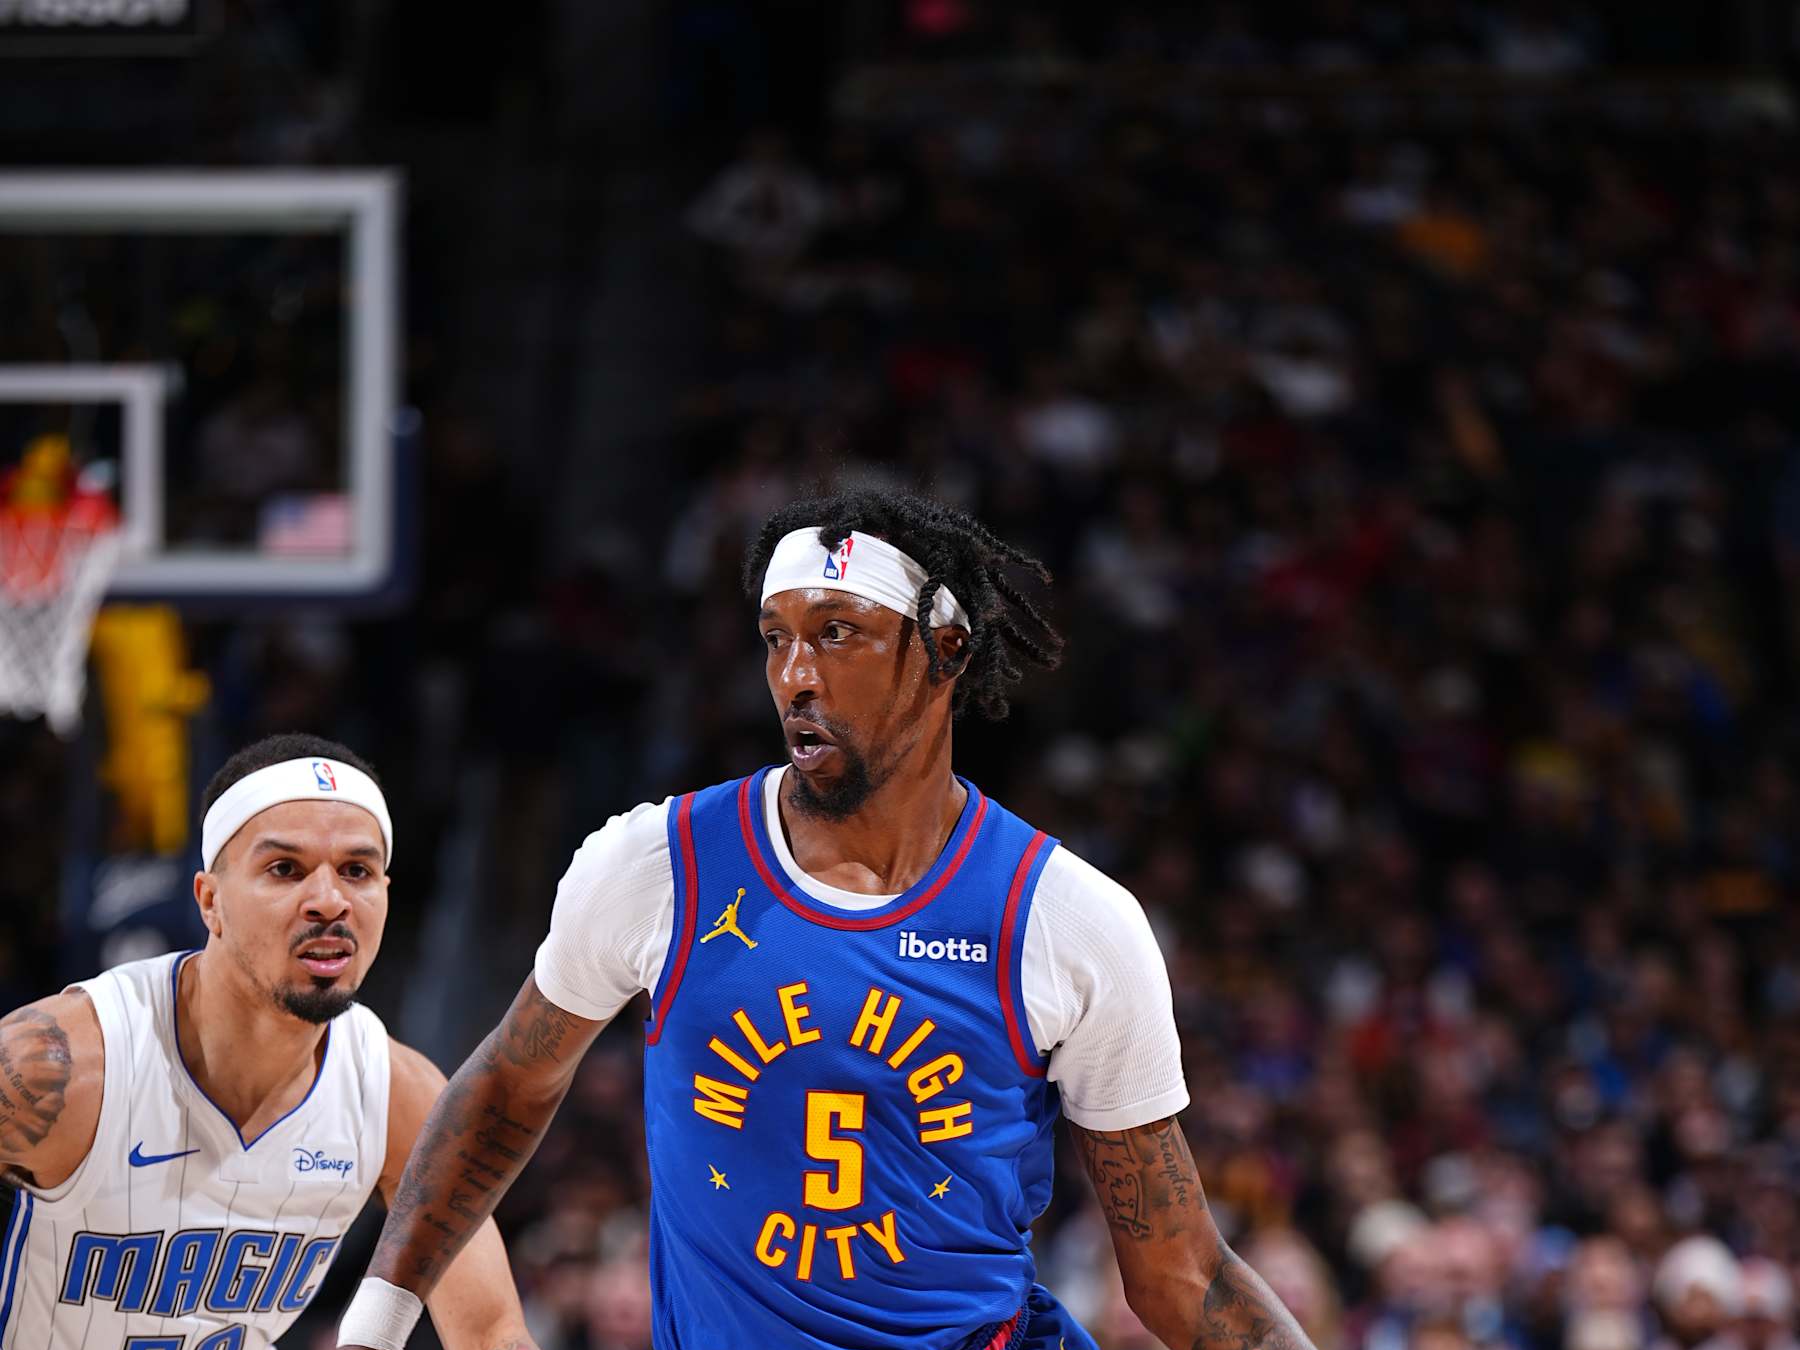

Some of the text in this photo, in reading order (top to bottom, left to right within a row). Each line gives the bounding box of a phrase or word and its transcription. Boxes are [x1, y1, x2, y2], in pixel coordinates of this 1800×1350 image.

[899, 931, 988, 963] ibotta
[693, 980, 822, 1130] MILE
[849, 987, 973, 1144] HIGH
[293, 1148, 354, 1178] Disney
[803, 1090, 867, 1211] 5
[59, 1227, 341, 1318] MAGIC
[755, 1210, 906, 1281] CITY
